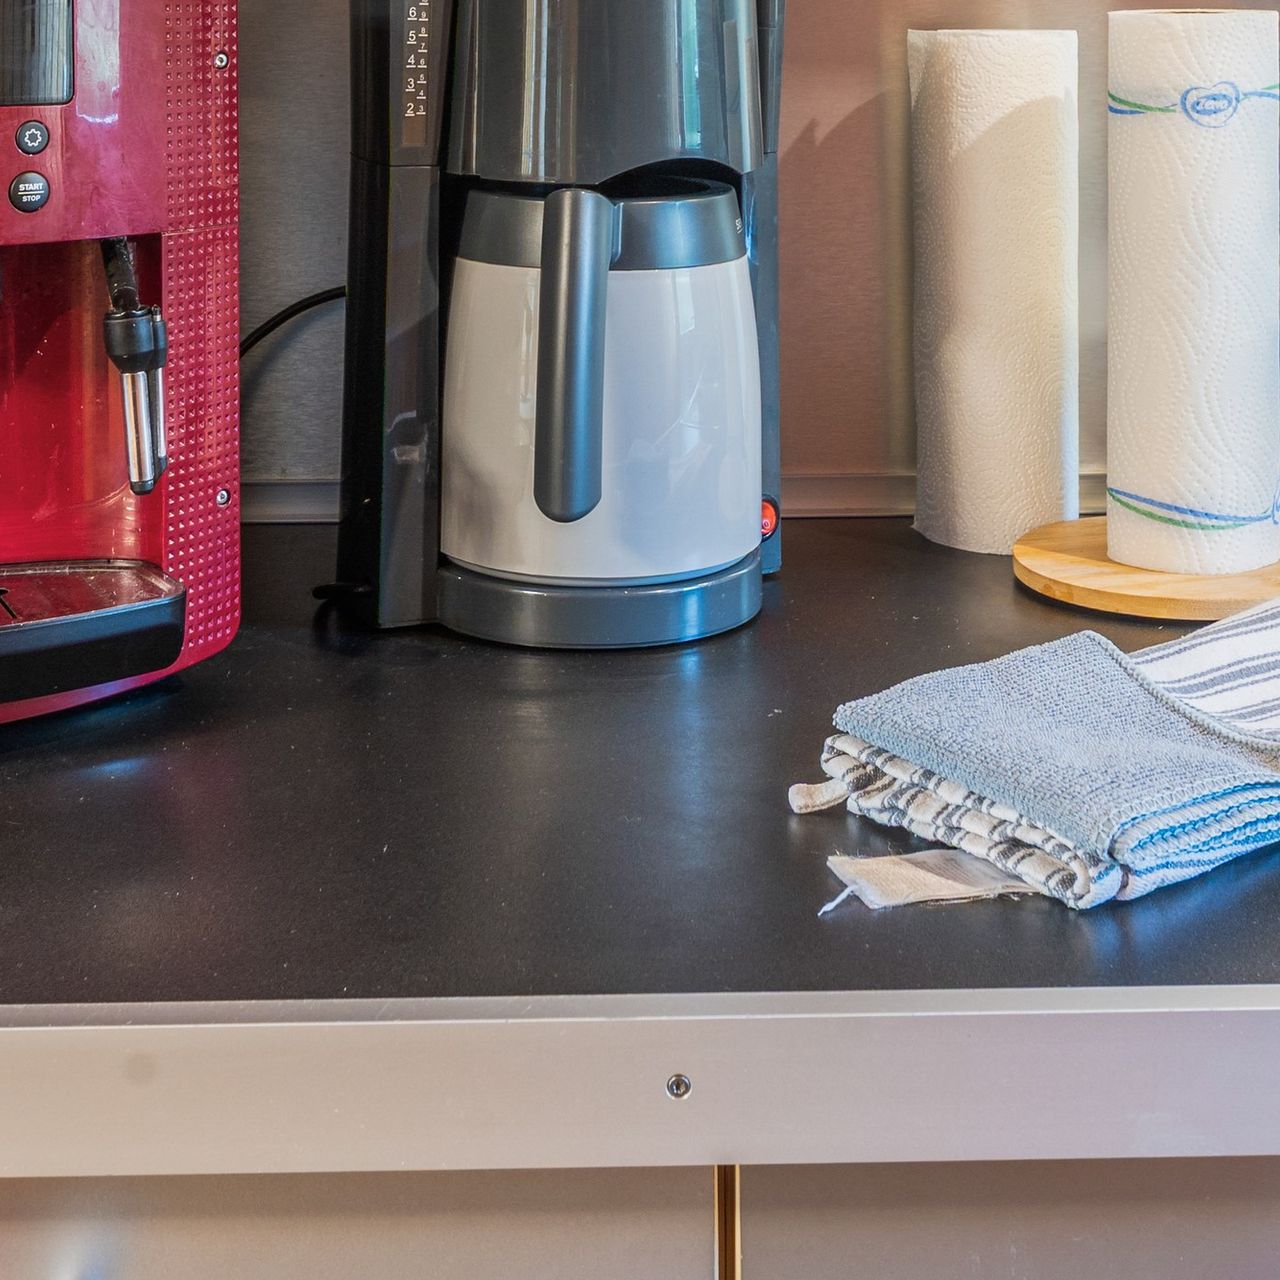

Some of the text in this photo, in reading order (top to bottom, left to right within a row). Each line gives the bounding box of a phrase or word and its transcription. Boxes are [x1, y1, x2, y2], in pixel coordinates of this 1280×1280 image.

[409, 6, 417, 18] 6
[408, 30, 416, 42] 5
[407, 53, 415, 65] 4
[407, 77, 415, 89] 3
[406, 102, 414, 114] 2
[19, 182, 44, 191] START
[22, 194, 41, 202] STOP
